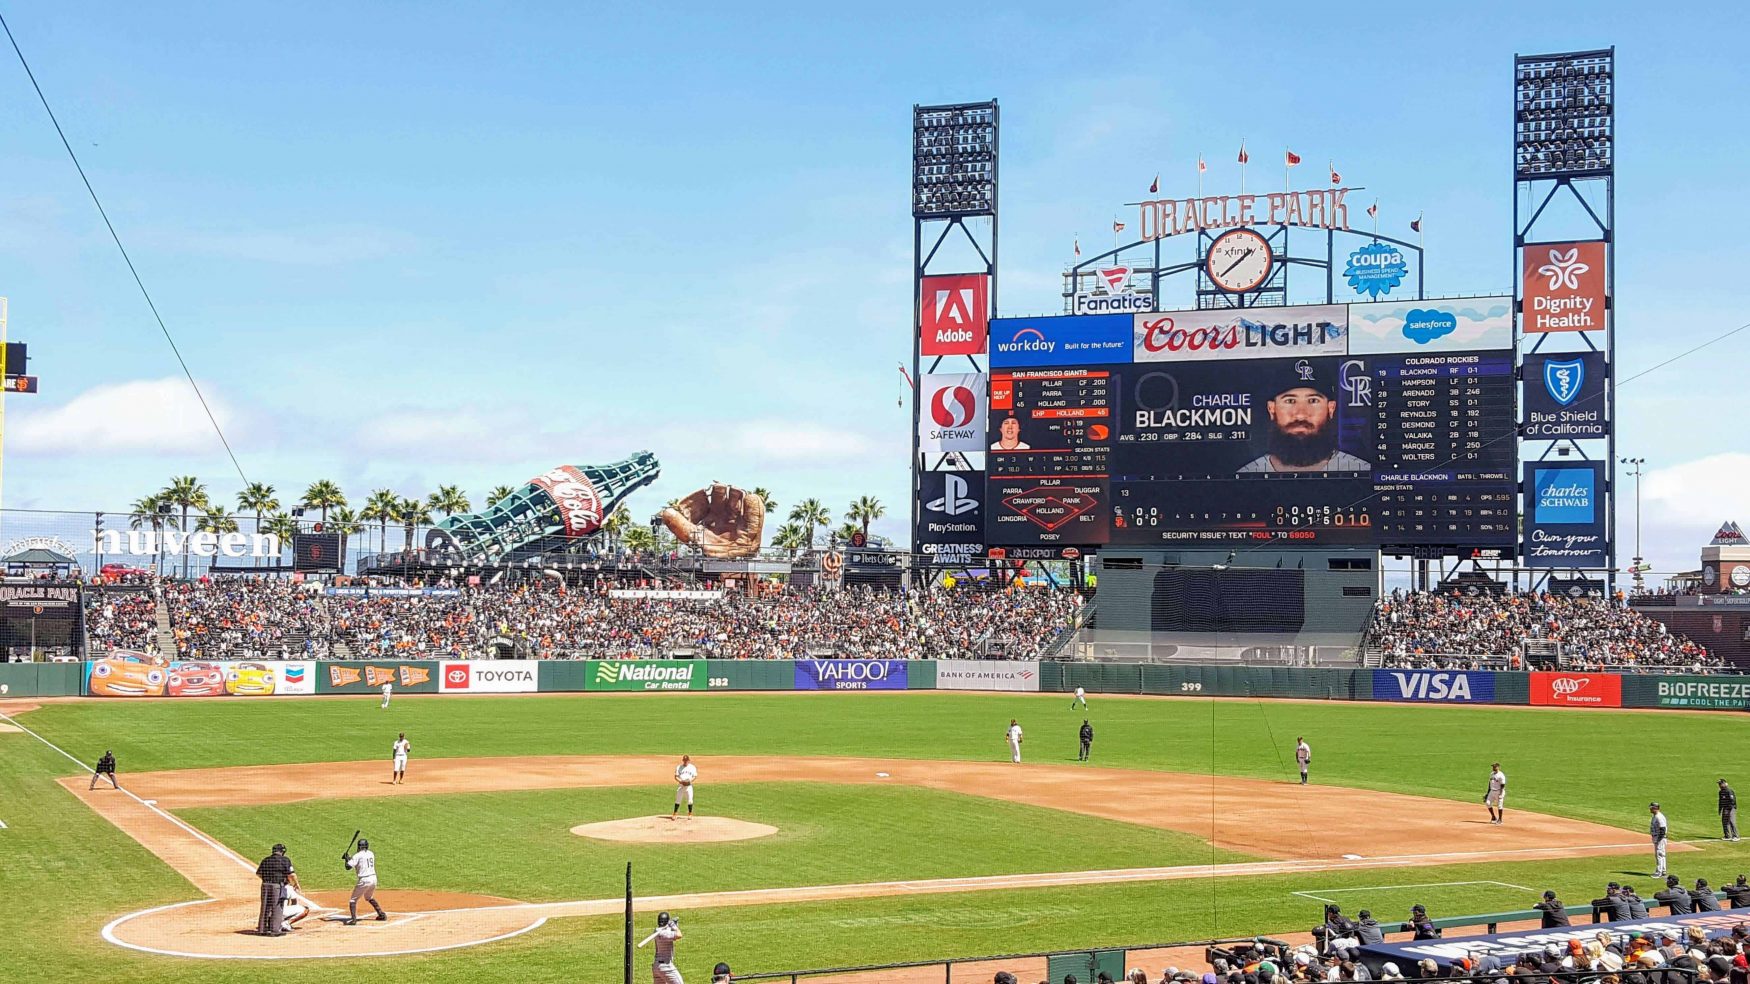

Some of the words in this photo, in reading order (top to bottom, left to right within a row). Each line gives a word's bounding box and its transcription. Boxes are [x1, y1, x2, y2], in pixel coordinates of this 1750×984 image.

[1141, 195, 1255, 241] ORACLE
[1267, 188, 1349, 230] PARK
[1352, 252, 1400, 268] coupa
[1078, 294, 1152, 312] Fanatics
[1534, 295, 1593, 313] Dignity
[1409, 320, 1452, 330] salesforce
[936, 329, 973, 342] Adobe
[1143, 317, 1240, 352] Coors
[1245, 322, 1331, 348] LIGHT
[998, 339, 1056, 352] workday
[1193, 394, 1251, 406] CHARLIE
[1136, 408, 1251, 428] BLACKMON
[1531, 412, 1556, 422] Blue
[1560, 410, 1596, 421] Shield
[1527, 424, 1538, 434] of
[1542, 423, 1602, 434] California
[930, 430, 974, 440] SAFEWAY
[1541, 484, 1588, 496] charles
[1541, 498, 1588, 506] SCHWAB
[928, 523, 976, 533] PlayStation
[89, 529, 282, 558] nuveen
[1532, 530, 1562, 542] Own
[1564, 536, 1598, 548] your
[922, 544, 980, 554] GREATNESS
[1010, 549, 1056, 558] JACKPOT
[1531, 545, 1601, 556] tomorrow
[932, 554, 971, 564] AWAITS
[0, 587, 45, 601] ORACLE
[48, 588, 77, 602] PARK
[476, 671, 533, 682] TOYOTA
[619, 664, 694, 680] National
[814, 661, 889, 680] YAHOO!
[708, 678, 728, 686] 382
[1182, 682, 1202, 691] 399
[1390, 672, 1472, 700] VISA
[1556, 679, 1576, 692] AAA
[366, 858, 374, 868] 19
